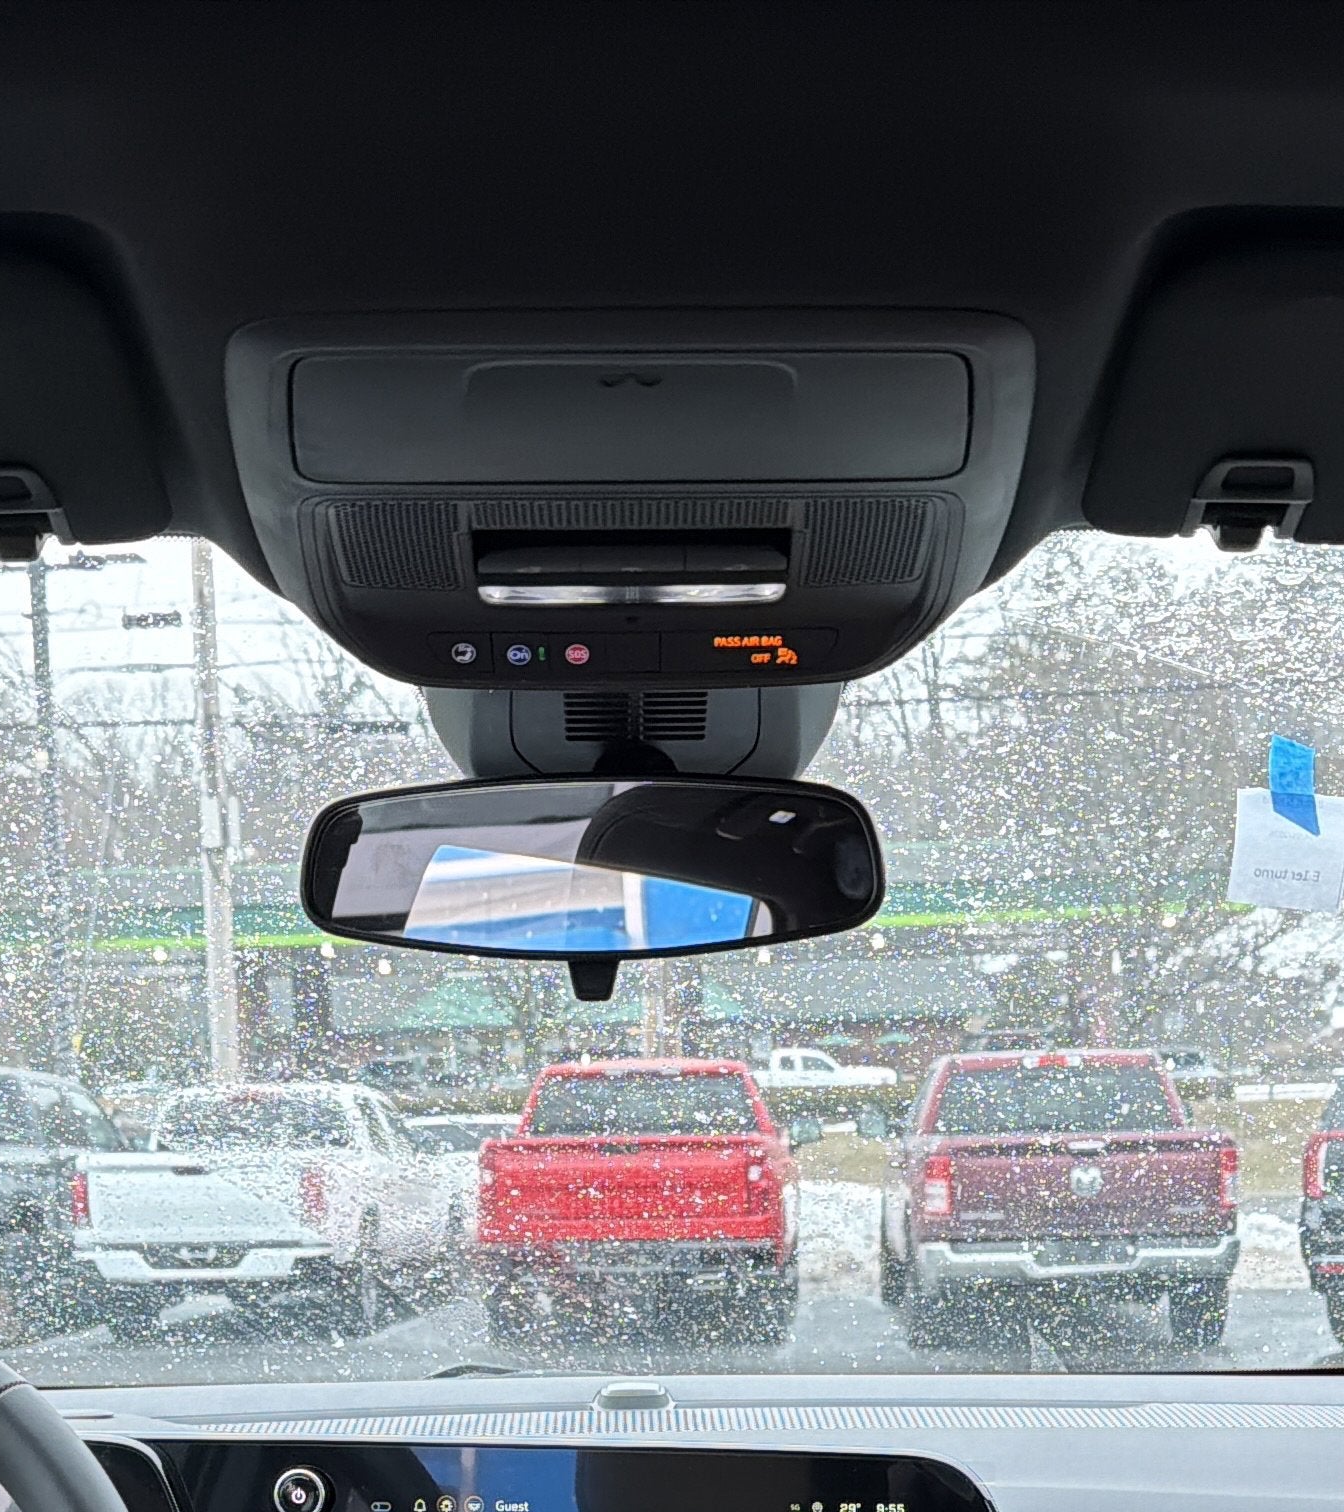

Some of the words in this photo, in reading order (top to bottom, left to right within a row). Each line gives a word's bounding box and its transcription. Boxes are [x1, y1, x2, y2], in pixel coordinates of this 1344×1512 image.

[714, 636, 740, 647] PASS
[742, 636, 759, 647] AIR
[761, 636, 783, 647] BAG
[567, 648, 588, 660] SOS
[751, 653, 772, 664] OFF
[495, 1500, 530, 1512] Guest
